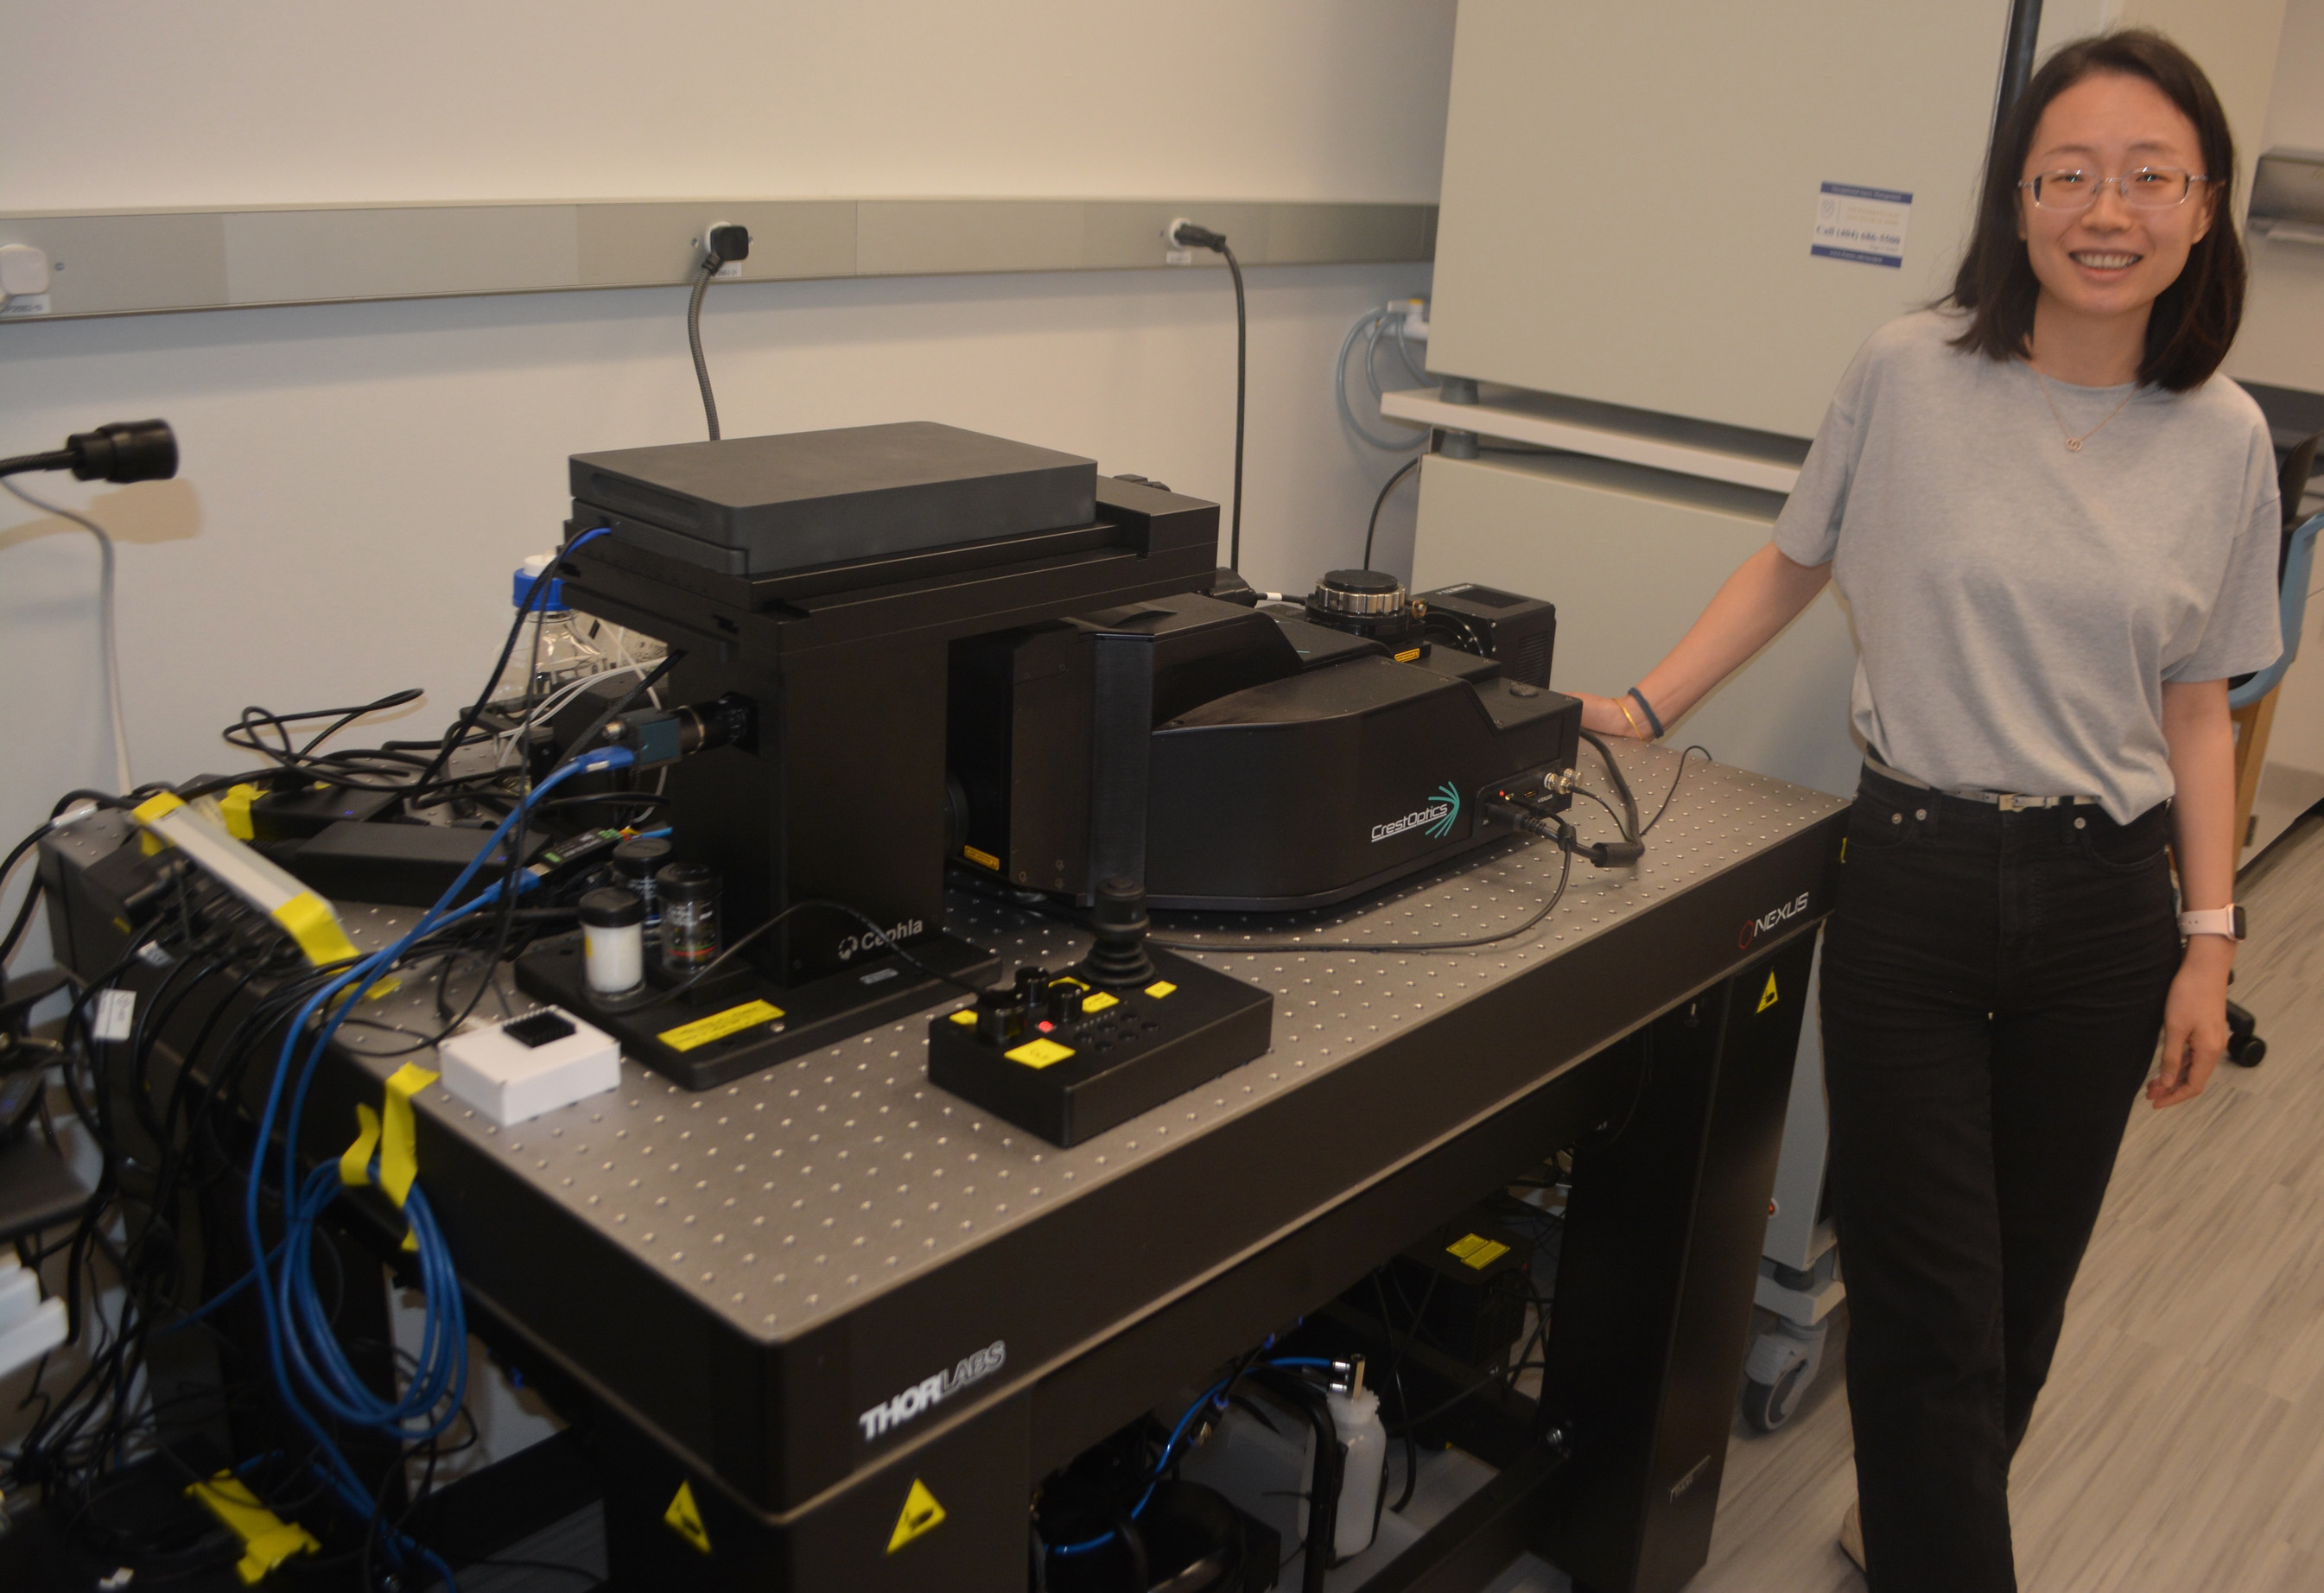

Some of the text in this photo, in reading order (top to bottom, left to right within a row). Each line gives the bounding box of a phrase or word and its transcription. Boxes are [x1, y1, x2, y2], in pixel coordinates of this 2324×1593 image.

[1371, 803, 1448, 842] CrestOptics
[1754, 892, 1809, 937] NEXUS
[859, 1340, 1006, 1441] THORLABS
